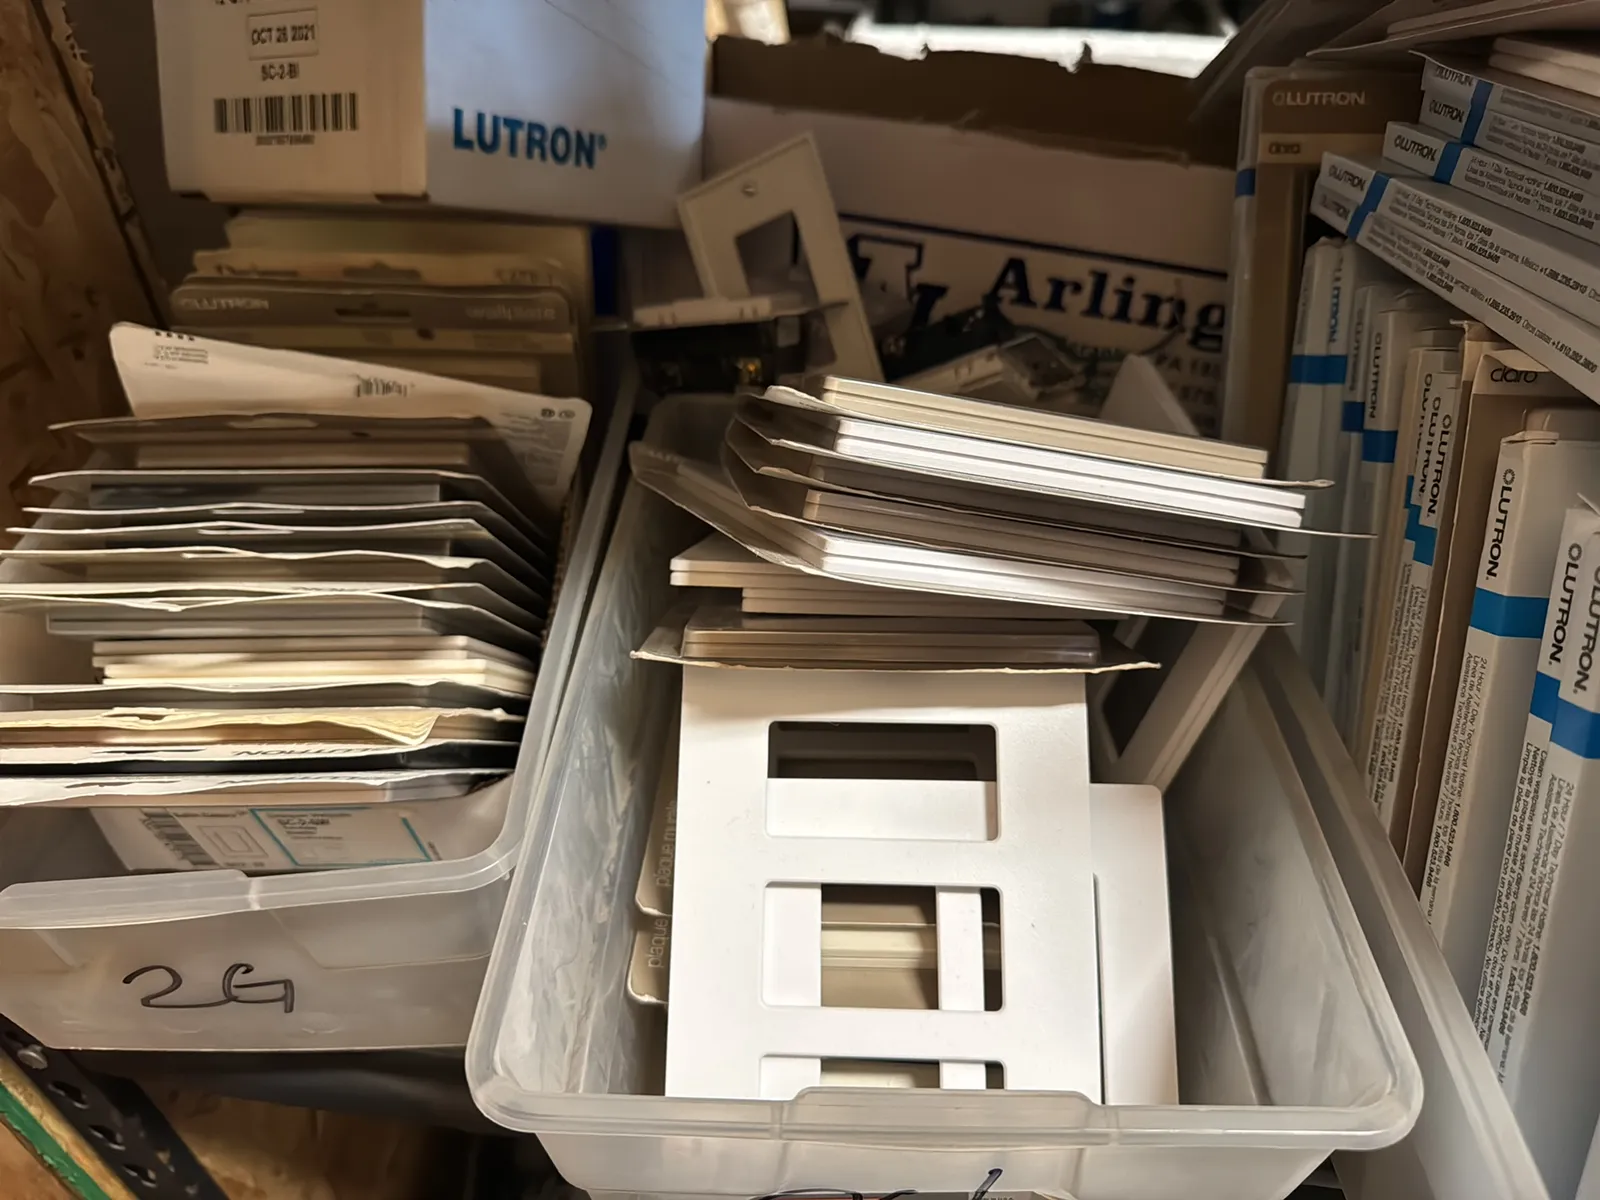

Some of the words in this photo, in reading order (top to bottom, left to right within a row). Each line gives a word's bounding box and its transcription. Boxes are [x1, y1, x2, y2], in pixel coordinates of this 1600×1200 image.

[251, 27, 273, 45] OCT
[1286, 91, 1366, 106] LUTRON
[1433, 102, 1464, 123] LUTRON
[453, 107, 597, 170] LUTRON
[1399, 139, 1438, 162] LUTRON
[1333, 168, 1366, 191] LUTRON
[1369, 344, 1382, 419] LUTRON
[1490, 366, 1538, 384] claro
[1427, 429, 1450, 515] LUTRON
[1486, 484, 1513, 578] LUTRON
[1549, 561, 1579, 663] LUTRON
[1574, 585, 1600, 692] LUTRON
[1476, 671, 1484, 692] Hour
[1469, 708, 1478, 725] Day
[1462, 729, 1475, 767] Technical
[1527, 746, 1539, 786] Nettoyer
[1537, 750, 1547, 777] Clean
[1514, 786, 1523, 812] placa
[1528, 781, 1540, 821] wallplate
[1518, 799, 1528, 832] plaque
[1506, 828, 1515, 856] pared
[1524, 824, 1532, 843] with
[1512, 834, 1522, 865] murale
[1497, 876, 1506, 888] un
[1510, 872, 1522, 899] damp
[647, 917, 668, 969] plaque
[1500, 948, 1508, 961] Do
